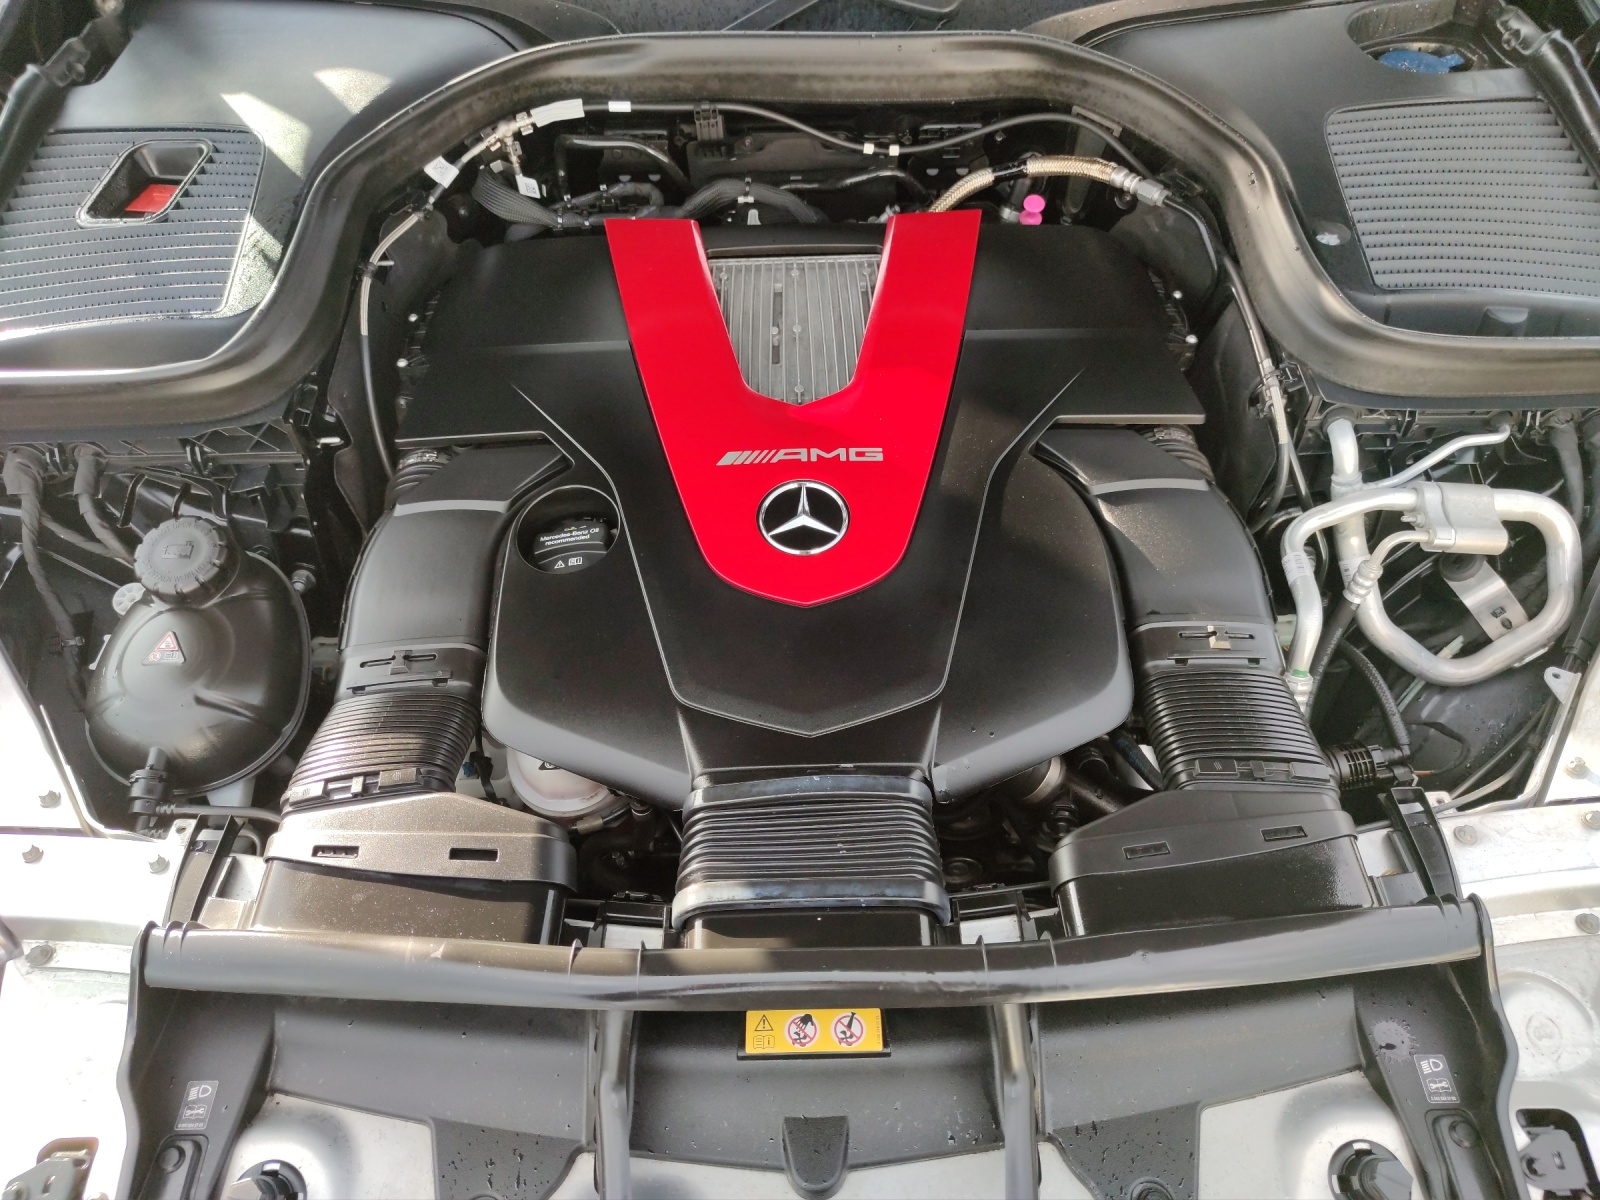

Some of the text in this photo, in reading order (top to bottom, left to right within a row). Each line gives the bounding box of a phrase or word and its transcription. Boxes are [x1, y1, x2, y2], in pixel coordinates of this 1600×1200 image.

[770, 447, 883, 463] AMG
[539, 529, 589, 541] Mercedes-Benz
[545, 534, 590, 546] recommended
